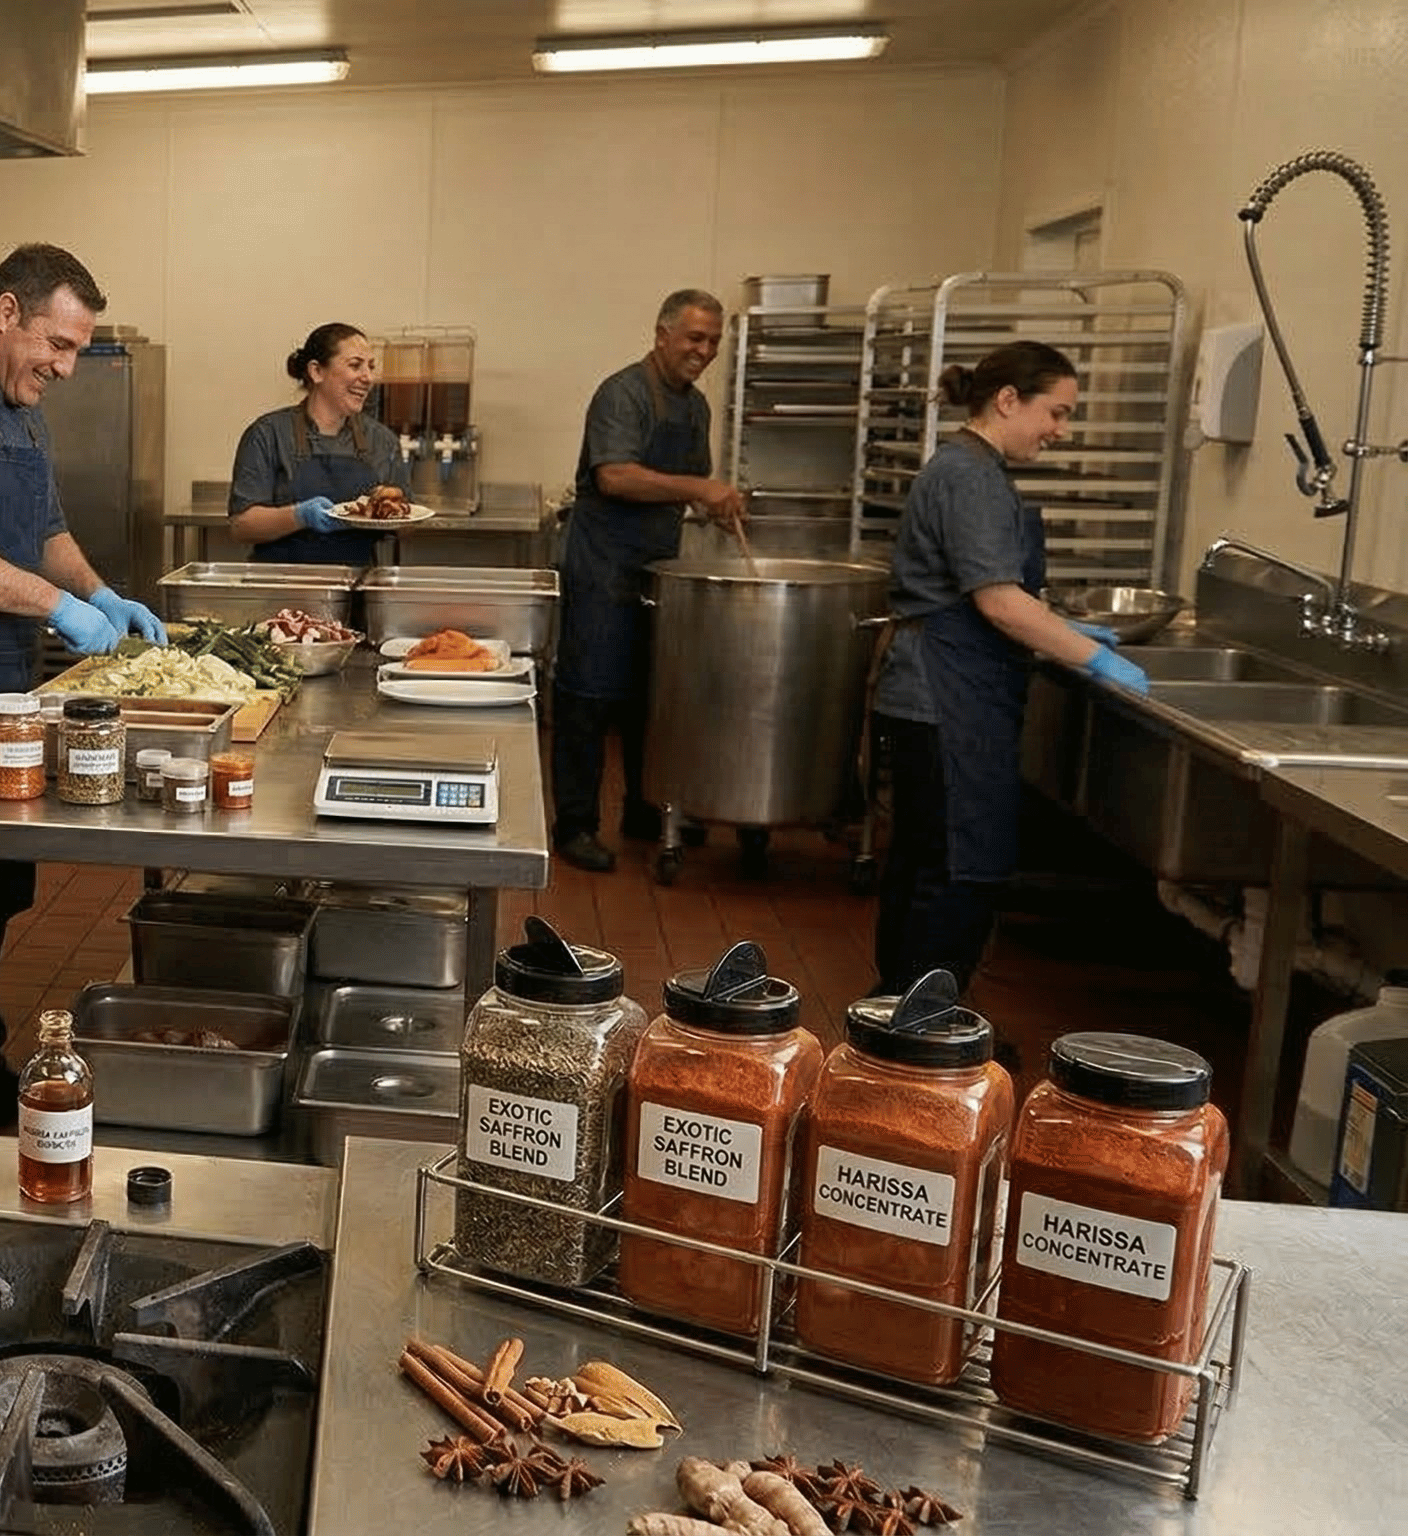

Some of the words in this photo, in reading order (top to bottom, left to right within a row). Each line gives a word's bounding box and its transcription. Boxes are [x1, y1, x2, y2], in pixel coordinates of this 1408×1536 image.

[488, 1097, 553, 1126] EXOTIC
[479, 1116, 562, 1149] SAFFRON
[663, 1115, 733, 1145] EXOTIC
[489, 1140, 549, 1167] BLEND
[653, 1135, 743, 1169] SAFFRON
[664, 1159, 728, 1187] BLEND
[838, 1165, 929, 1203] HARISSA
[819, 1183, 948, 1228] CONCENTRATE
[1043, 1213, 1146, 1255] HARISSA
[1022, 1232, 1167, 1280] CONCENTRATE
